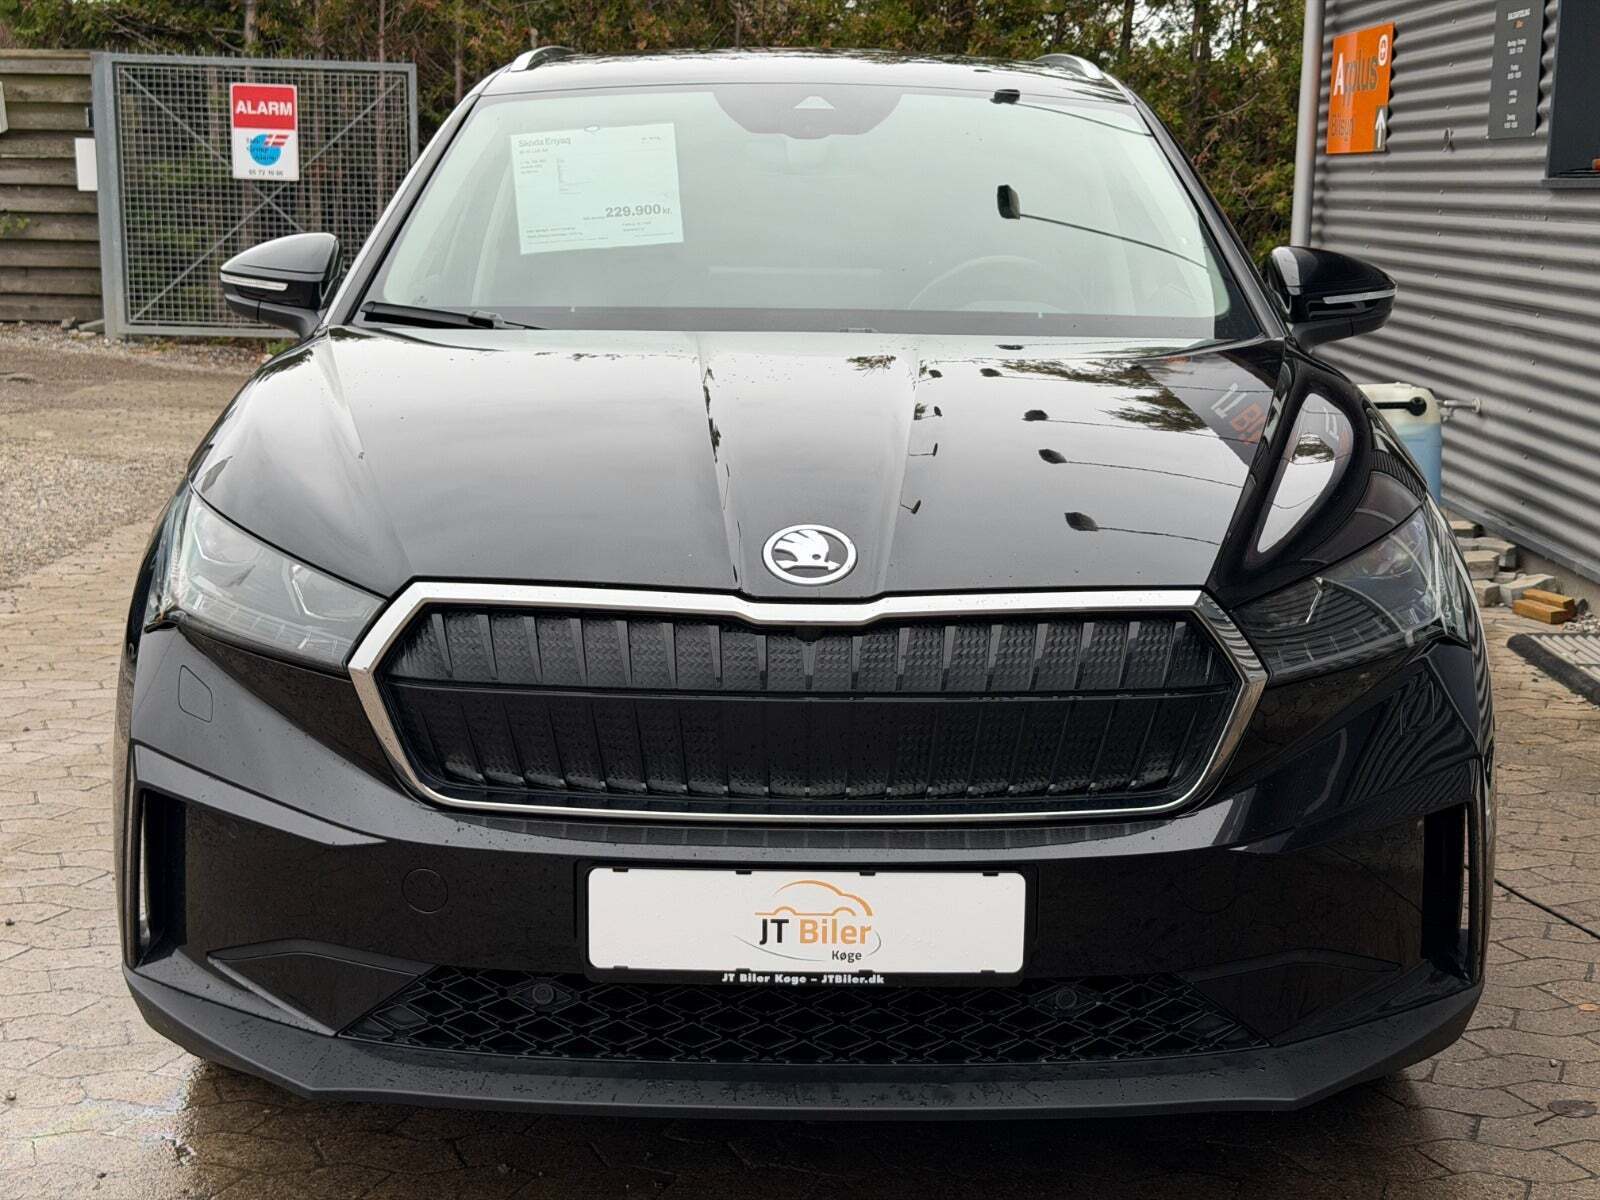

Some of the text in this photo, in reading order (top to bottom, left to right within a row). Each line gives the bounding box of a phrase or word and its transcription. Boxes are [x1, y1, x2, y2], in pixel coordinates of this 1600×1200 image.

[236, 100, 292, 116] ALARM
[605, 203, 661, 218] 229.900
[759, 918, 872, 945] JT Biler
[832, 949, 862, 964] Køge
[721, 972, 735, 983] JT
[739, 973, 770, 984] Biler
[821, 974, 885, 985] JTBiler.dk
